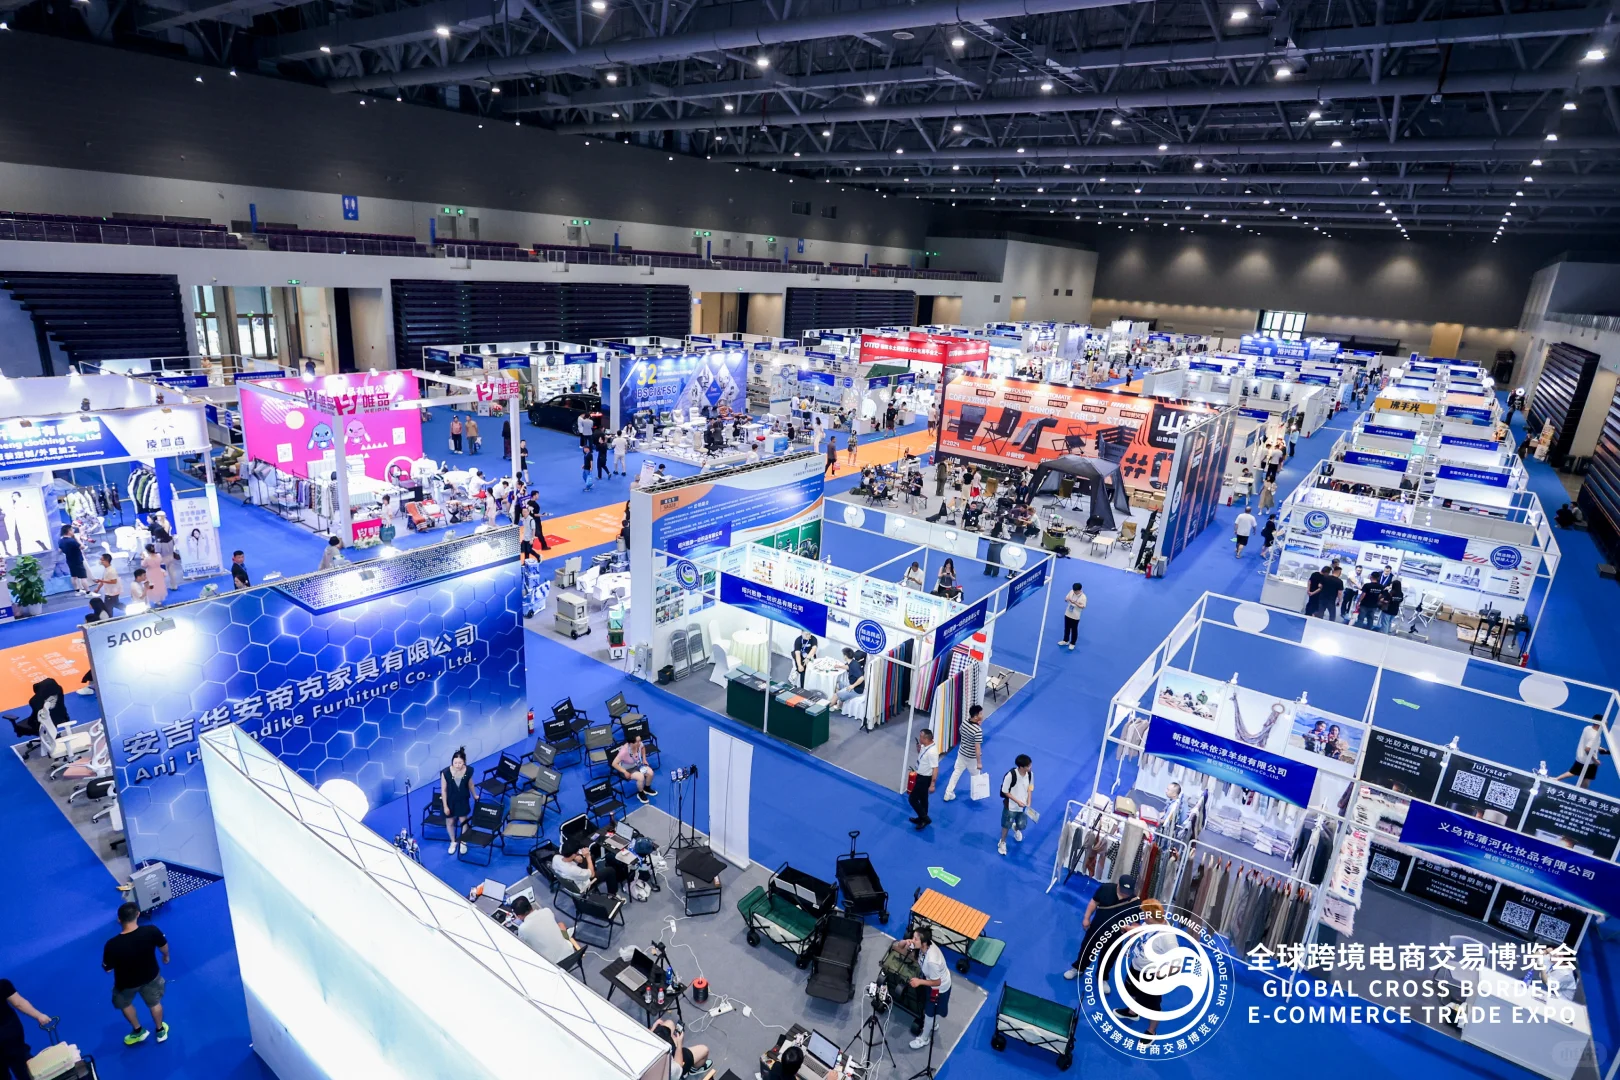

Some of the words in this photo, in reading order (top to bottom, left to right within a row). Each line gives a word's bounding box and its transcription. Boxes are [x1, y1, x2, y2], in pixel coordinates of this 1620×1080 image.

[637, 363, 657, 385] 32
[497, 382, 519, 395] 唯品
[637, 385, 678, 399] BSCI&FSC
[362, 393, 390, 407] 唯品
[363, 406, 390, 414] WEIPIN
[1028, 405, 1062, 417] CANOPY
[25, 437, 65, 447] clothing
[123, 623, 478, 763] 安吉华安帝克家具有限公司
[312, 679, 398, 719] Furniture
[448, 651, 478, 670] Ltd.
[1376, 735, 1437, 759] 哑光防水眼线膏
[1472, 762, 1508, 778] Julystar
[1546, 786, 1619, 815] 持久提亮高光液
[1437, 821, 1596, 881] 义乌市蒲河化妆品有限公司
[1463, 838, 1478, 849] Yiwu
[1481, 845, 1498, 855] Puhe
[1498, 851, 1533, 865] Cosmetics
[1548, 866, 1561, 875] Ltd.
[1484, 853, 1534, 874] 展位号:5A020
[1521, 893, 1558, 912] Julystar
